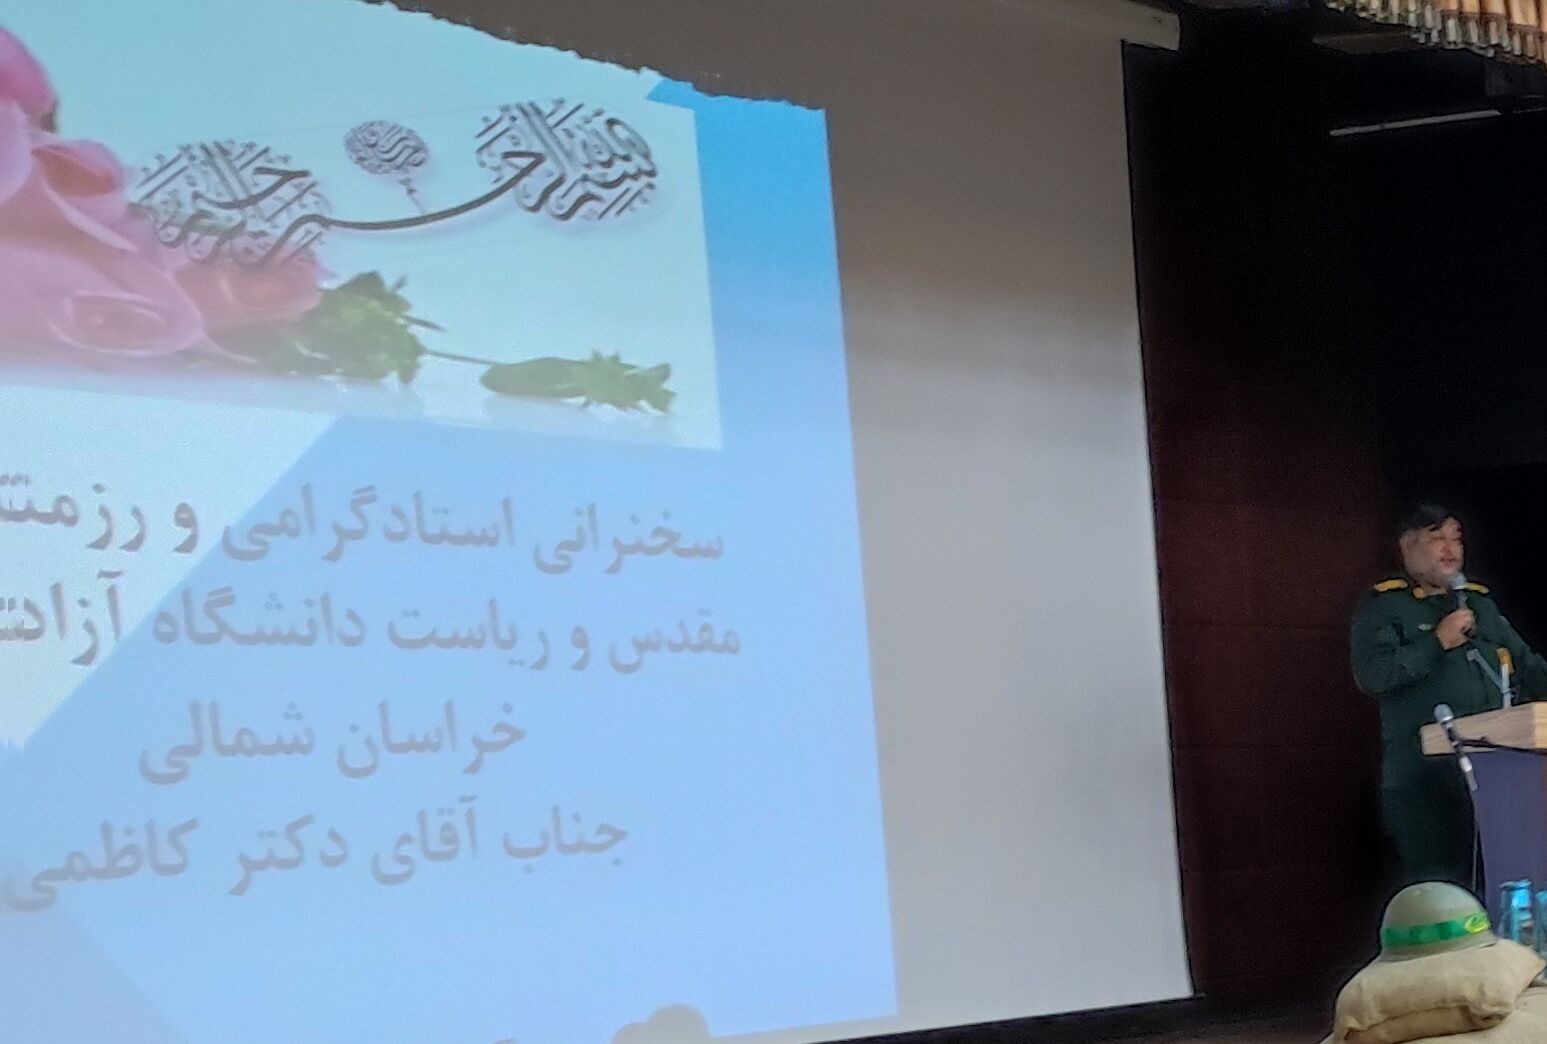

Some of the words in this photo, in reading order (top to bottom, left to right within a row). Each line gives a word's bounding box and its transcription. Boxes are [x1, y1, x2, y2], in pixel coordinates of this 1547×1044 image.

[173, 502, 200, 554] و
[532, 502, 725, 577] سخنرانی
[152, 584, 367, 649] دانشگاه
[386, 596, 548, 671] ریاست
[570, 628, 589, 671] و
[608, 605, 741, 674] مقدس
[138, 697, 316, 785] شمالی
[335, 701, 526, 778] خراسان
[8, 817, 197, 910] کاظمی
[228, 814, 348, 896] دکتر
[370, 795, 478, 886] آقای
[502, 803, 627, 873] جناب
